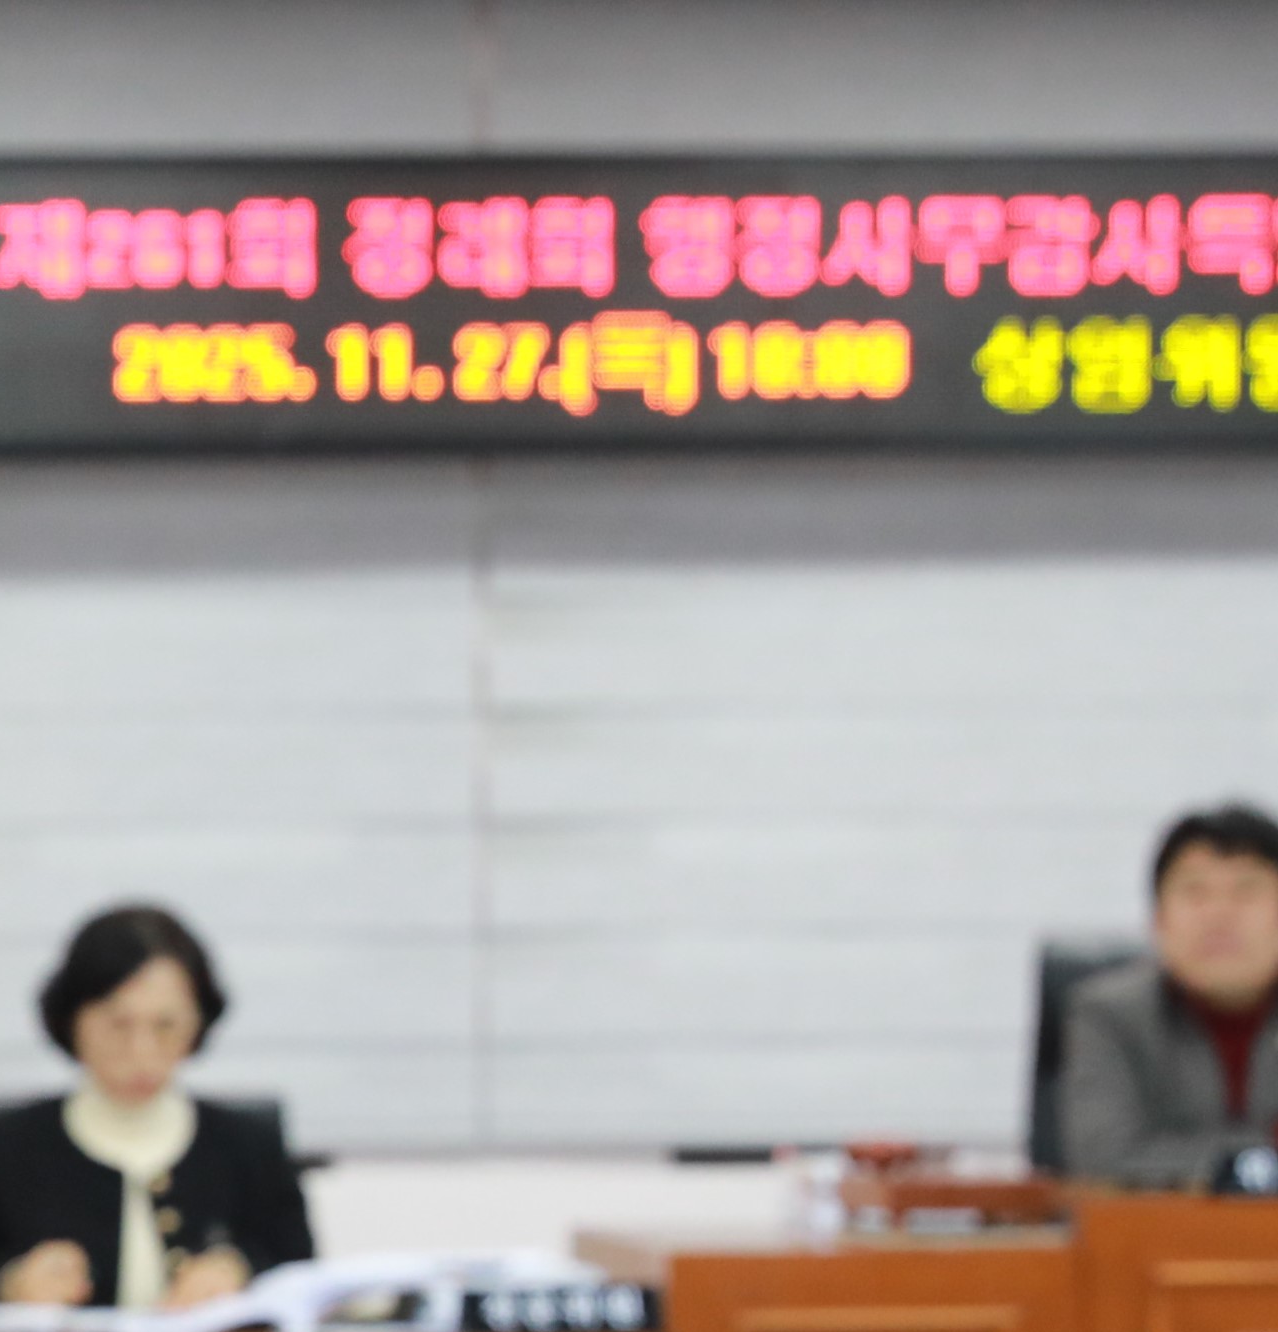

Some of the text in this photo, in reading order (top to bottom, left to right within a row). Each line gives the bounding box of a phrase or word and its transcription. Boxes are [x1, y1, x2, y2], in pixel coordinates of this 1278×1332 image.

[343, 196, 616, 298] 정례회
[640, 193, 1278, 298] 행정사무감사특
[113, 323, 318, 403] 2025.
[326, 322, 445, 403] 11.
[708, 321, 912, 400] 10:00
